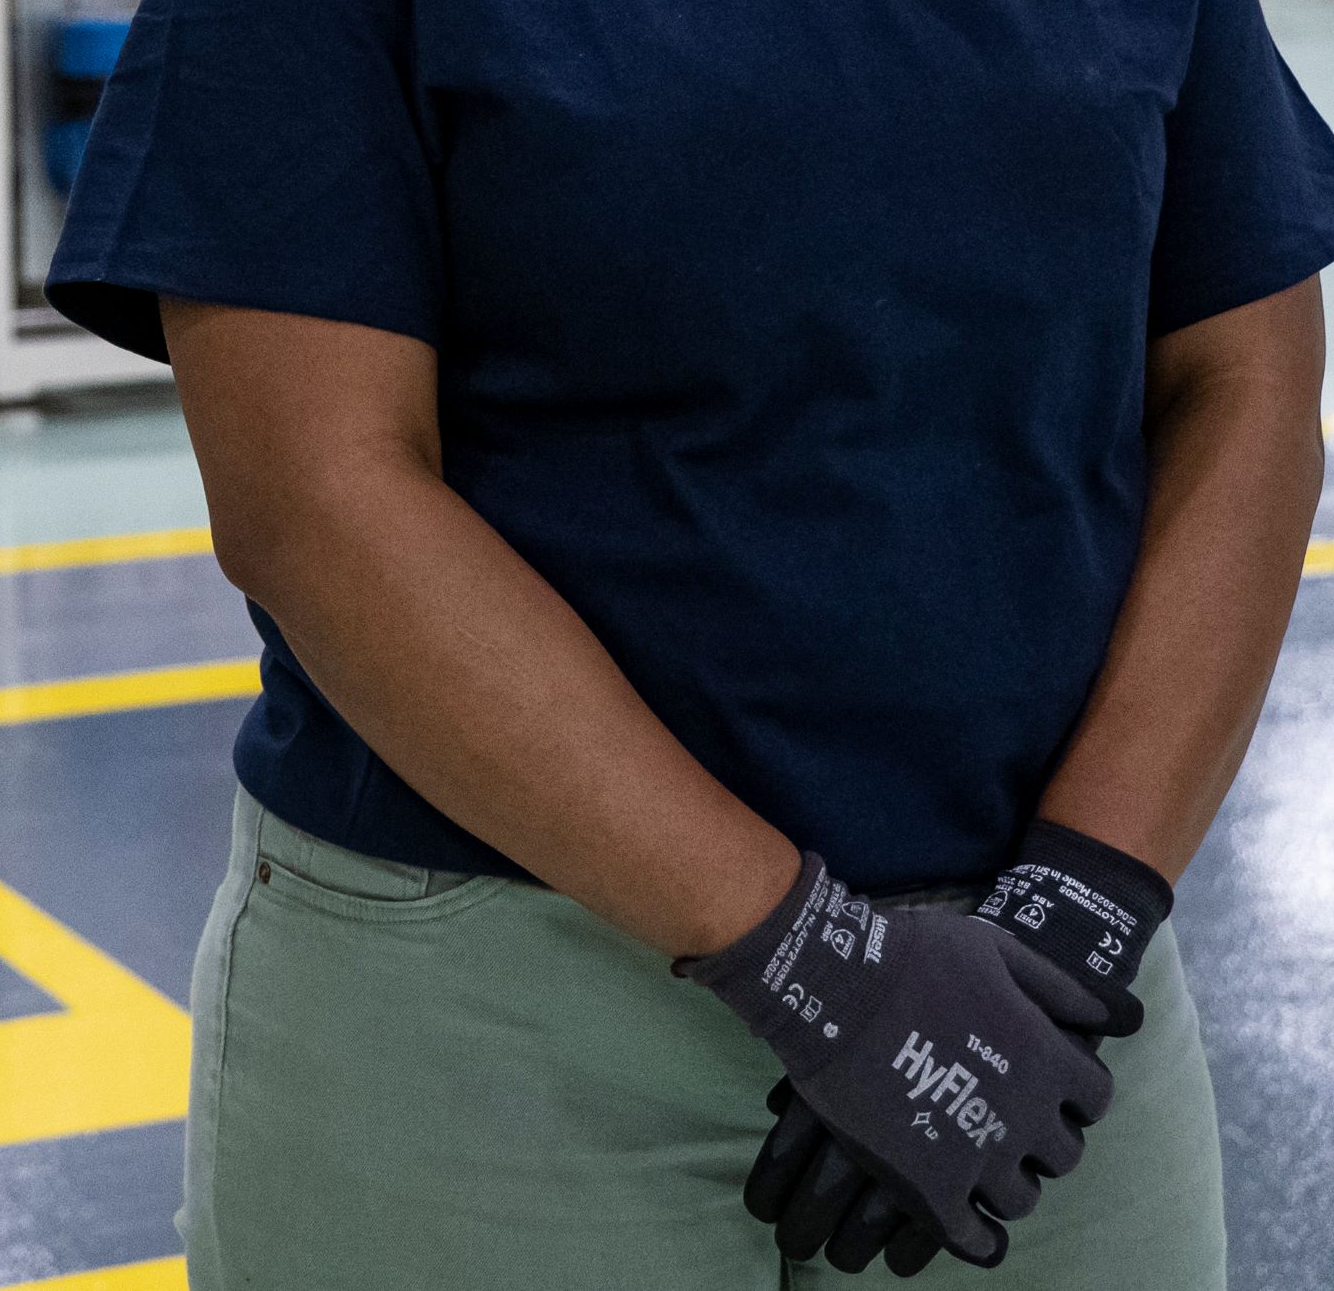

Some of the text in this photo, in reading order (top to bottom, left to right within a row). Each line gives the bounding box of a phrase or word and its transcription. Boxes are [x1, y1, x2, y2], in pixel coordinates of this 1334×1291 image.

[1035, 865, 1051, 876] Sri
[1051, 870, 1062, 882] in
[1062, 875, 1091, 897] Made
[1032, 893, 1055, 908] ABR
[867, 914, 889, 963] Ansell
[967, 1033, 1009, 1074] 11-840
